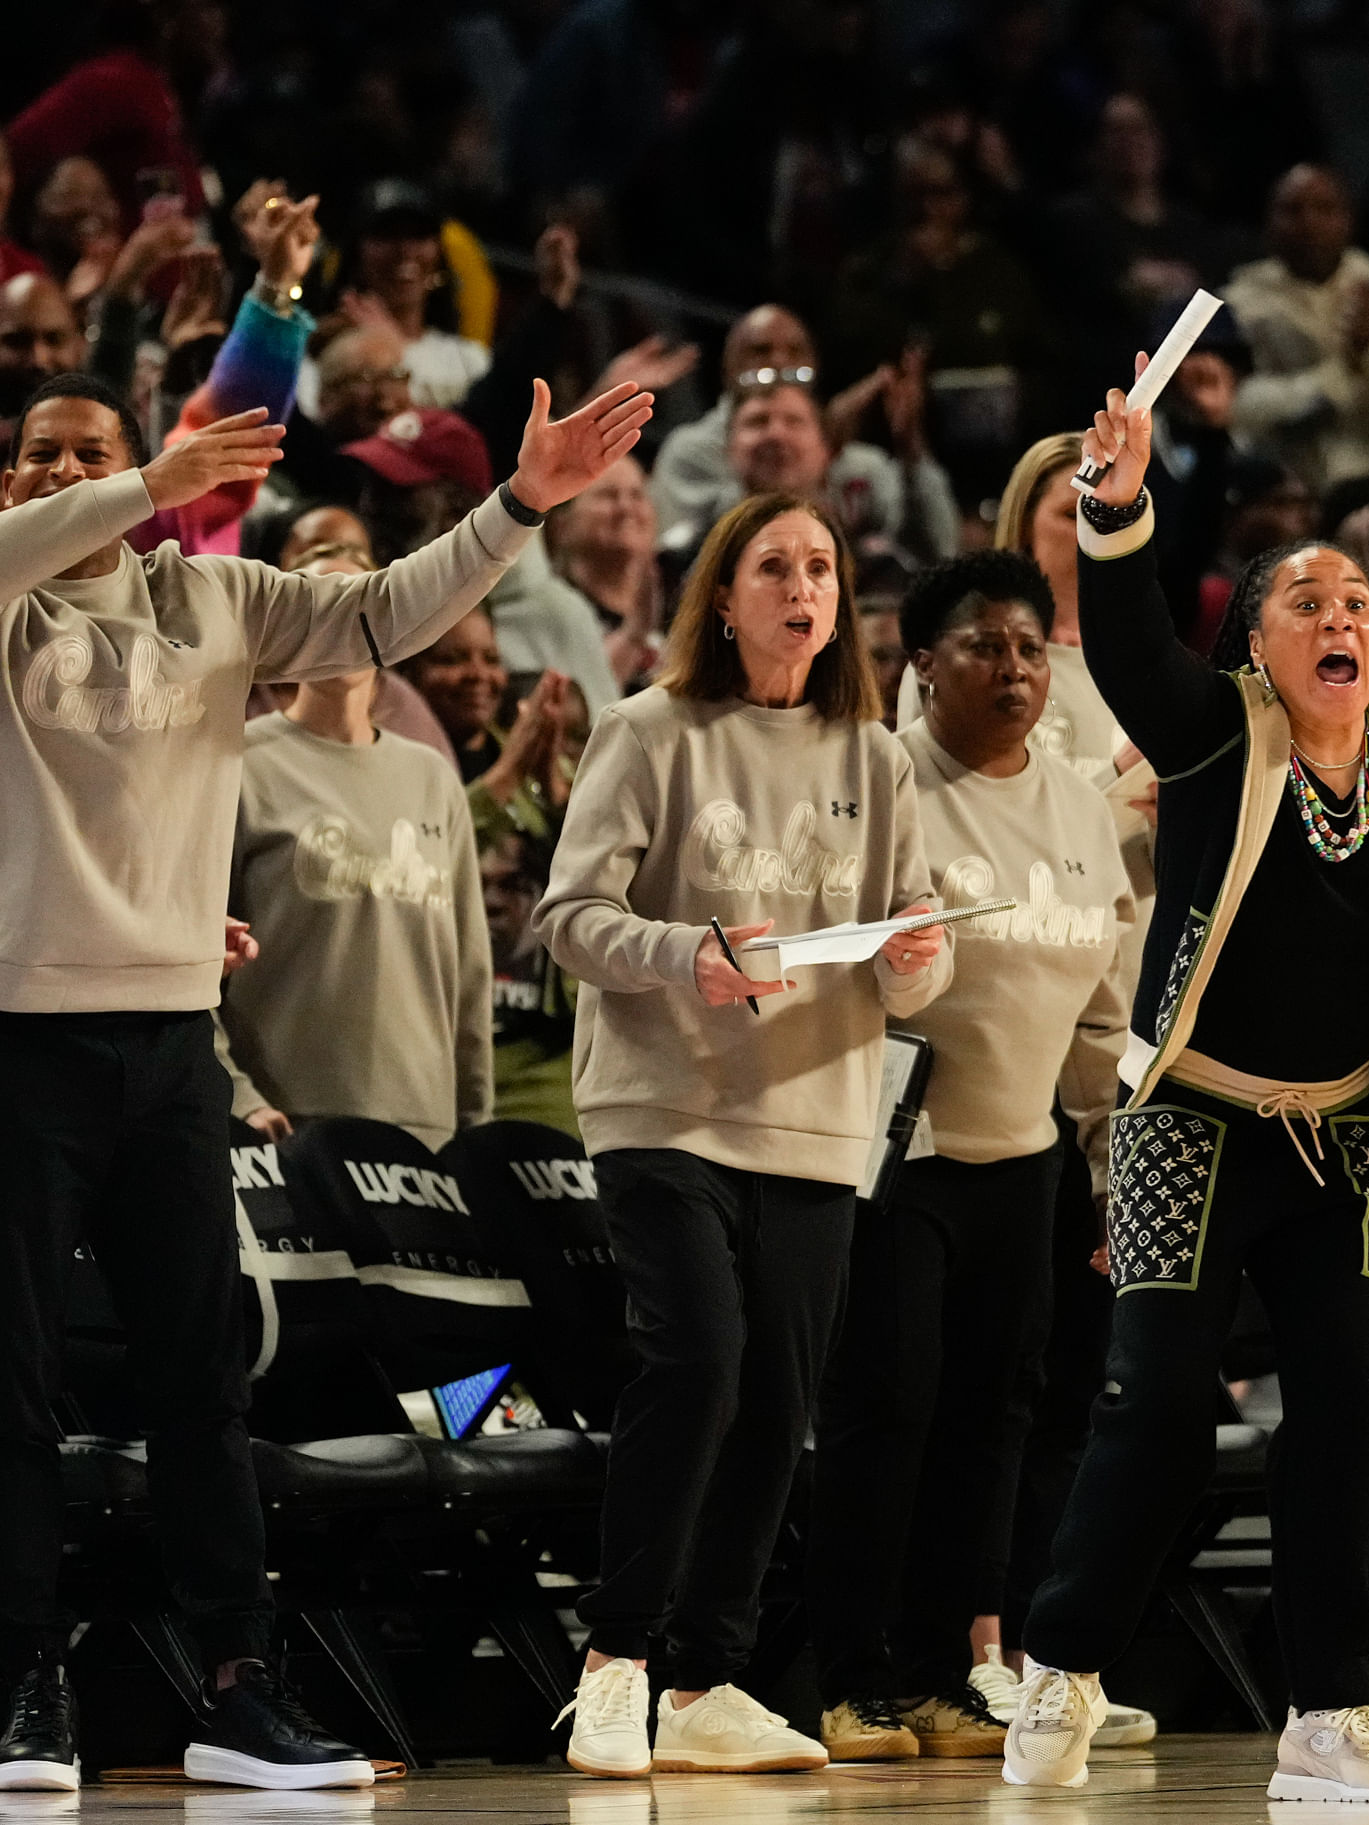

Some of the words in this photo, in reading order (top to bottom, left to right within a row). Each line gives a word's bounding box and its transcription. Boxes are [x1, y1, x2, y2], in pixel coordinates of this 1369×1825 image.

[682, 799, 858, 898] Carolina
[342, 1159, 470, 1217] LUCKY
[508, 1158, 599, 1201] LUCK
